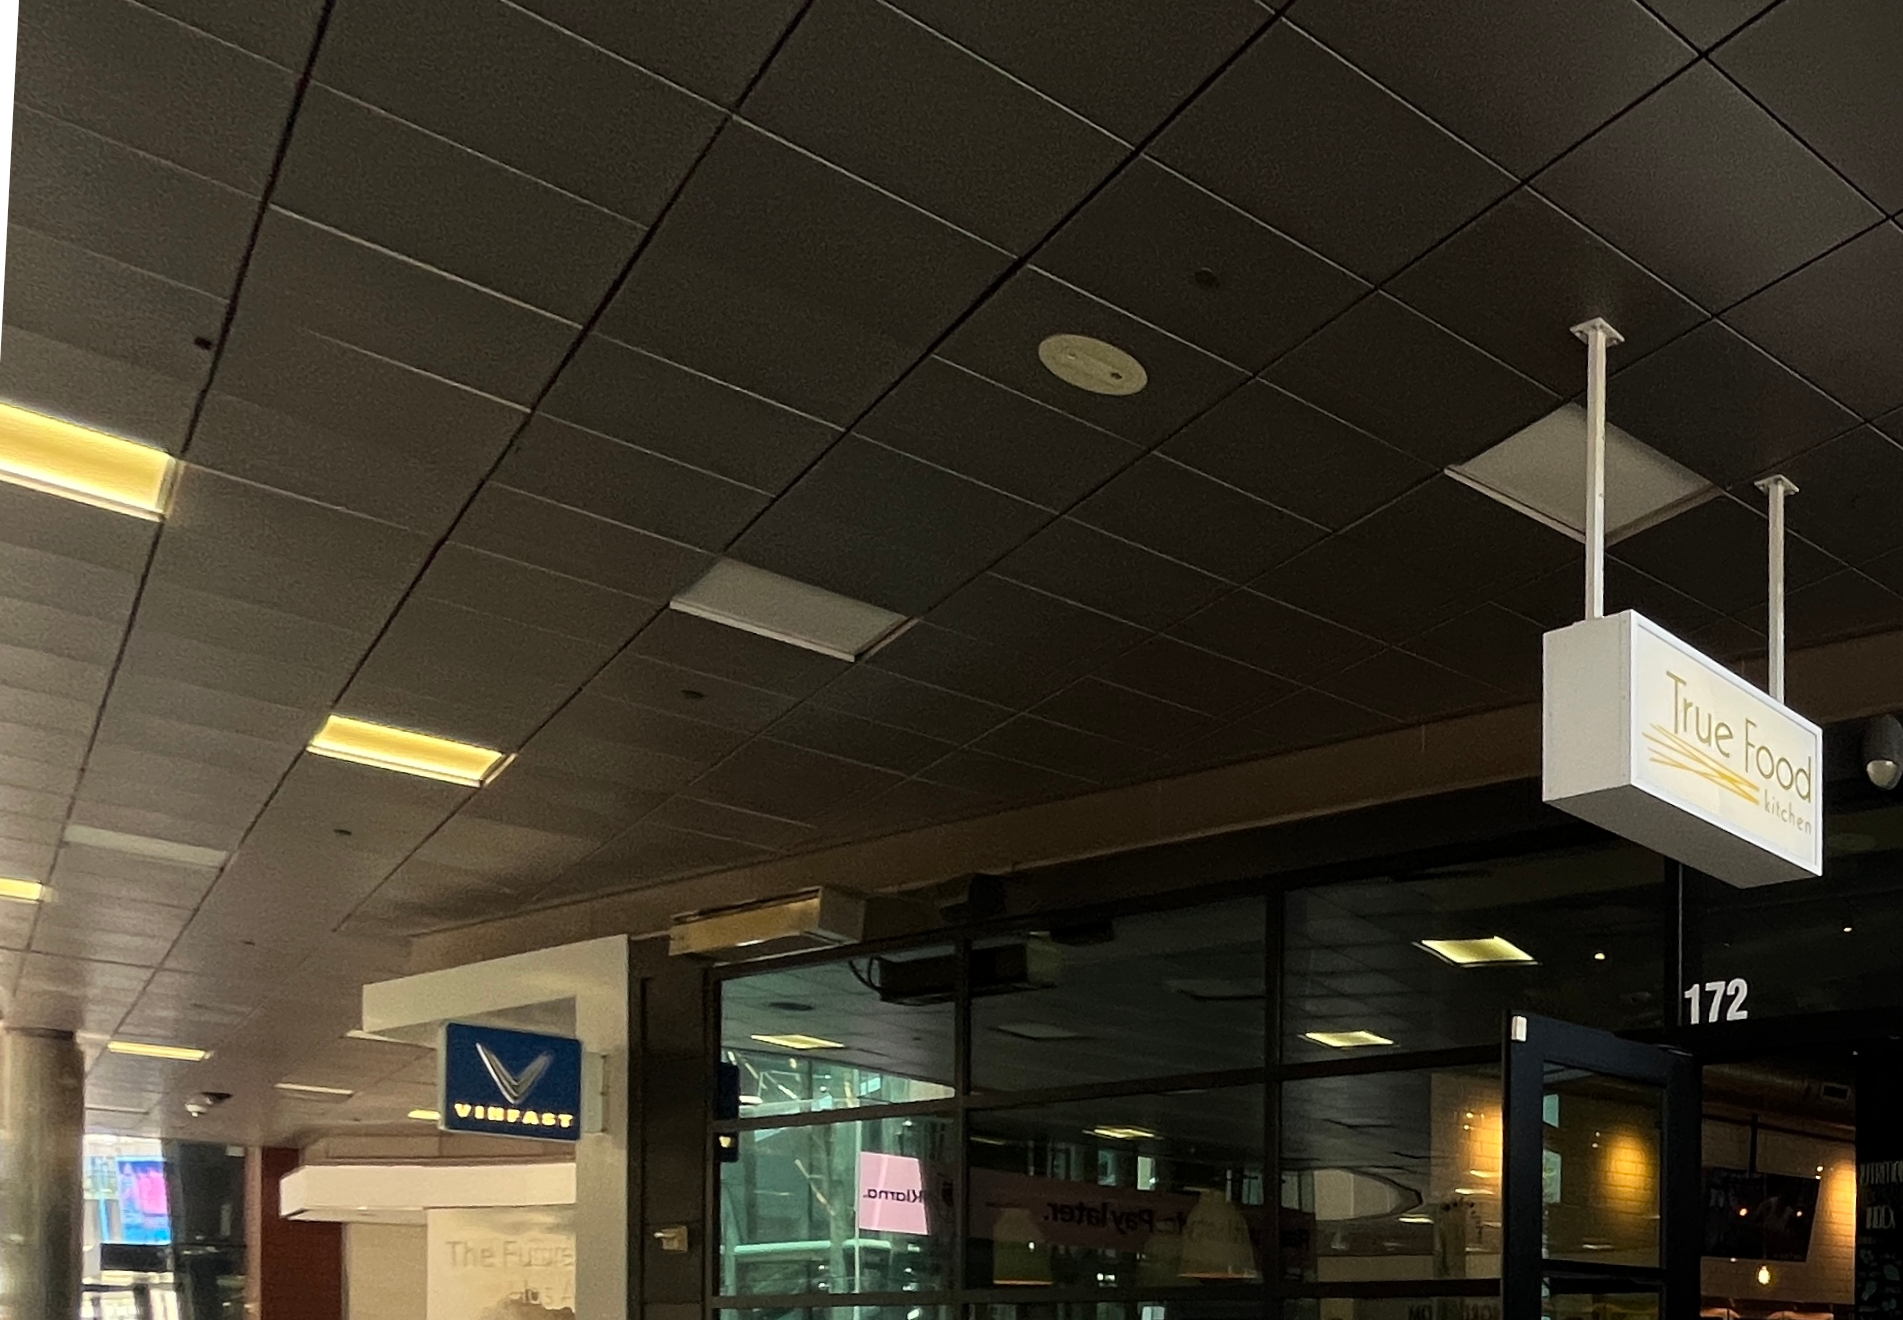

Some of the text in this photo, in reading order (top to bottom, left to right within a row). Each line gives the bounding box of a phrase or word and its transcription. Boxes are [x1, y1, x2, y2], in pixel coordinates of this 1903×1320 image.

[1666, 670, 1813, 804] True Food
[1763, 786, 1813, 836] kitchen
[1684, 978, 1749, 1025] 172
[454, 1102, 574, 1129] VINFAST
[445, 1239, 495, 1268] The
